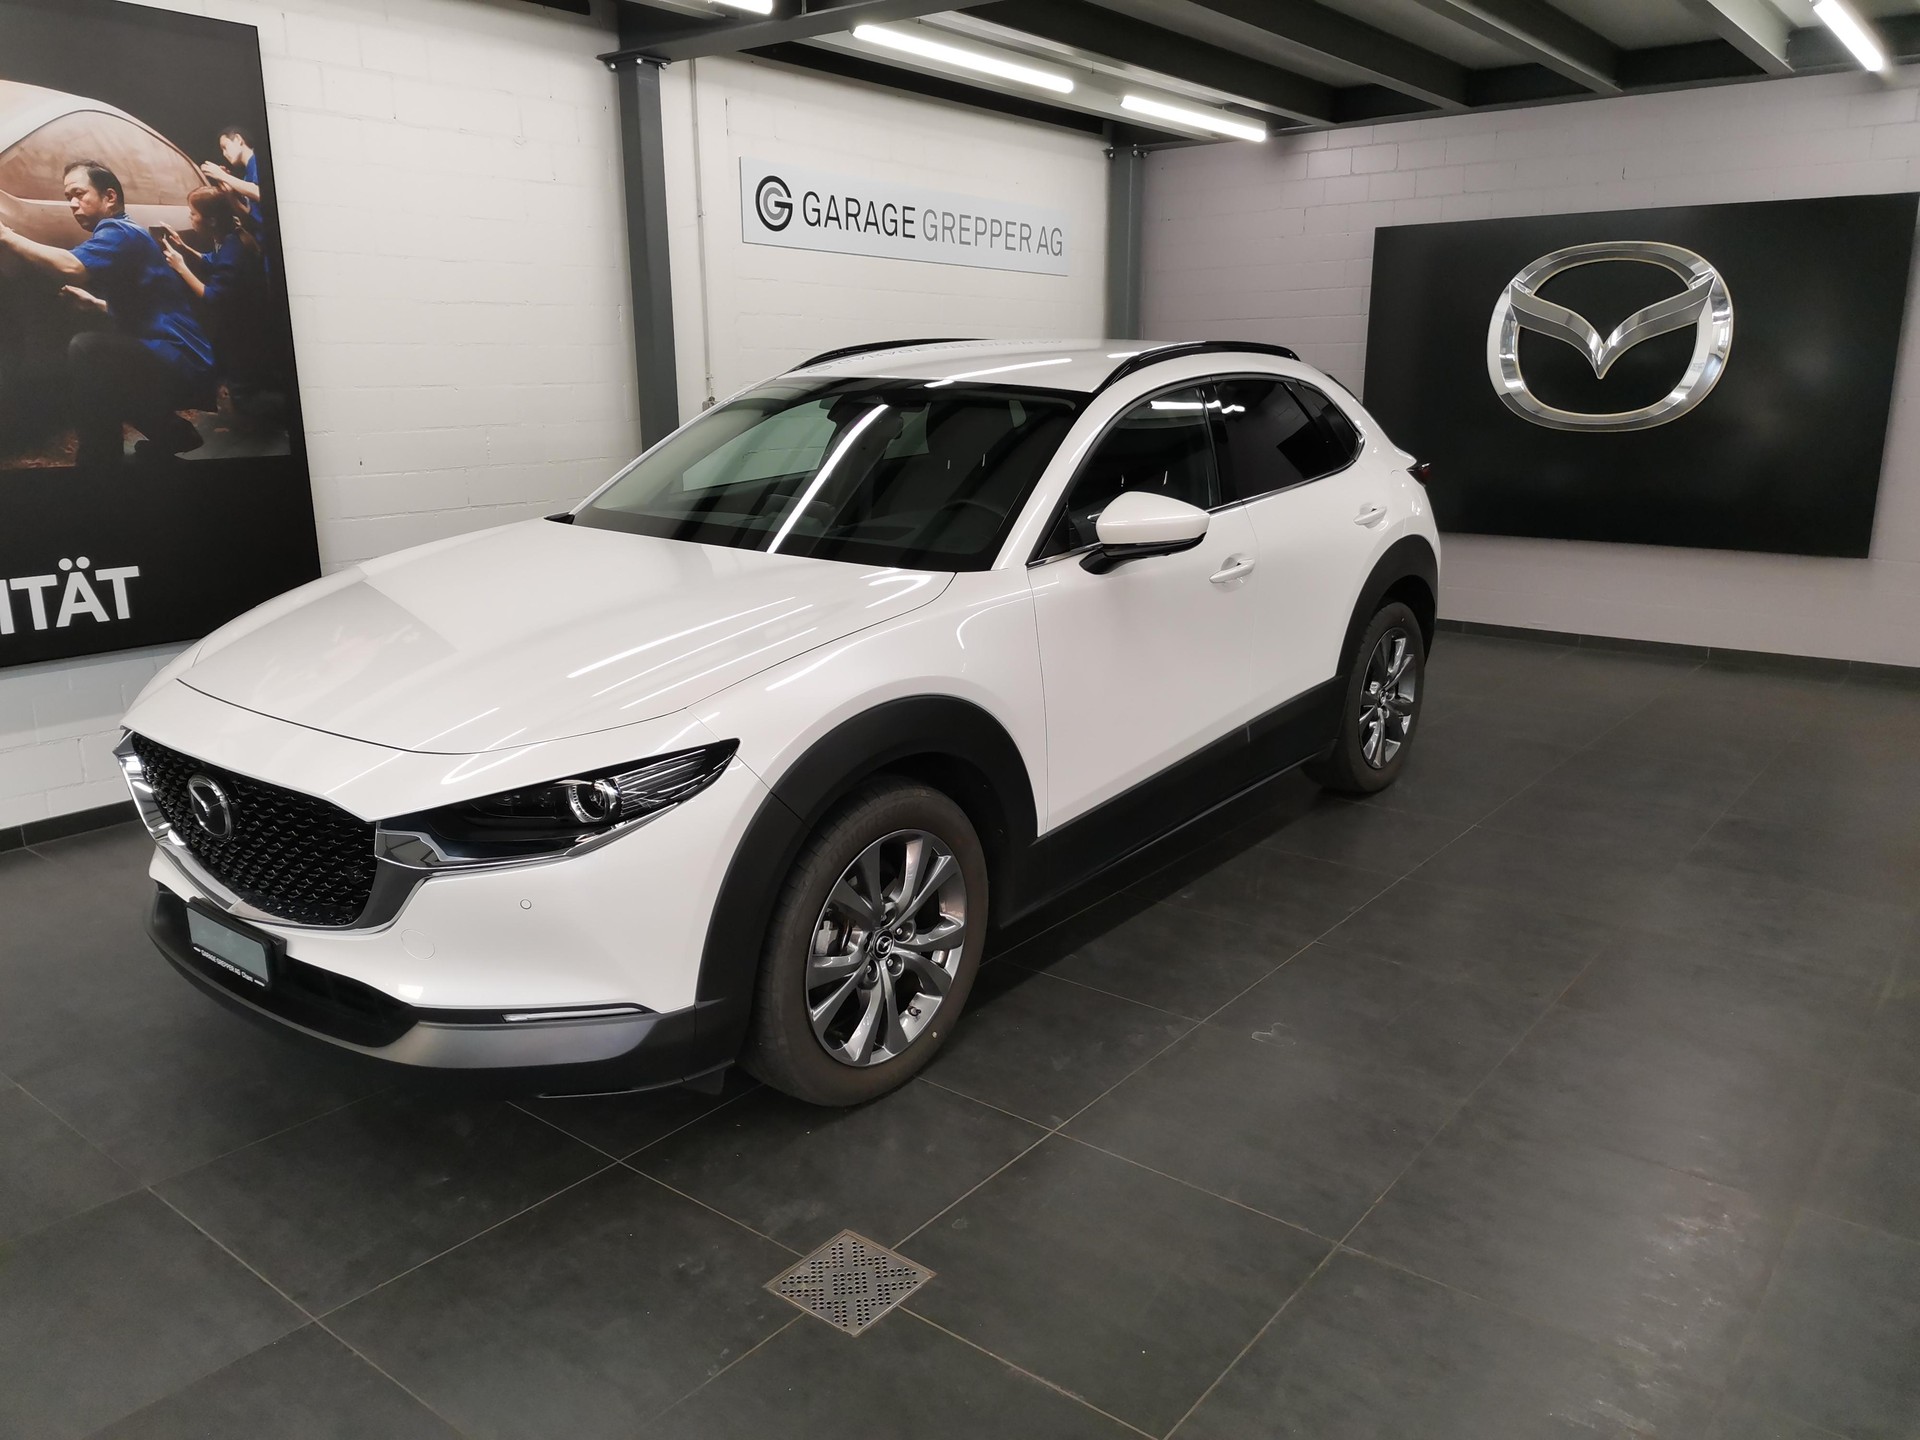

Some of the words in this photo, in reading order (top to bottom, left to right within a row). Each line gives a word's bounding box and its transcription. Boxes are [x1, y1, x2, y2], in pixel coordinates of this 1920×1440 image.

[802, 191, 916, 239] GARAGE
[923, 209, 1032, 253] GREPPER
[1036, 226, 1063, 257] AG
